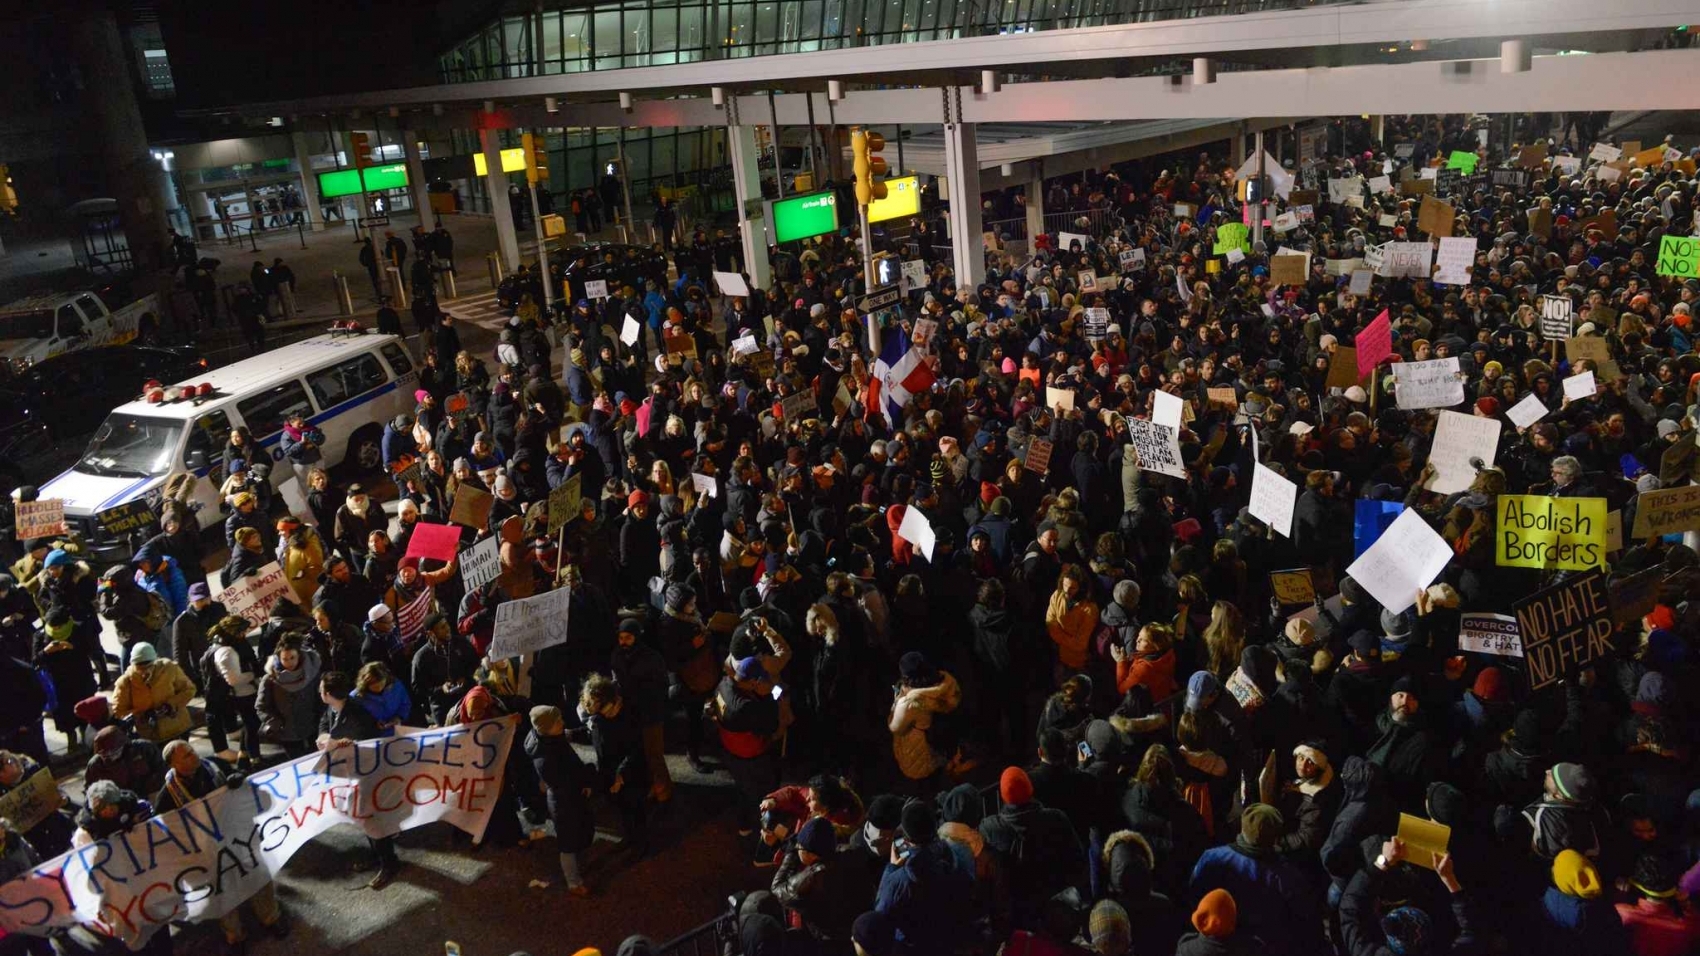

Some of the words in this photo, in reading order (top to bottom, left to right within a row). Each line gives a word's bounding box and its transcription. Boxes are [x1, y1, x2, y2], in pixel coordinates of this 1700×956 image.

[1663, 240, 1692, 257] NO
[1390, 252, 1422, 268] NEVER
[1661, 258, 1690, 273] NO
[869, 296, 883, 307] ONE
[884, 292, 898, 303] WAY
[1543, 299, 1569, 321] NO!
[1153, 423, 1173, 435] THEY
[1153, 431, 1169, 443] FOR
[1647, 493, 1678, 508] THIS
[106, 515, 139, 535] THEM
[1504, 499, 1592, 536] Abolish
[1504, 530, 1600, 566] Borders
[217, 587, 236, 603] END
[228, 569, 283, 606] DETAINMENT
[239, 585, 290, 617] EPORTATION
[1517, 602, 1550, 649] NO
[1548, 574, 1607, 632] HATE
[1464, 620, 1518, 632] OVERCO
[1466, 631, 1514, 643] BIGOTRY
[1483, 639, 1491, 648] &
[1526, 643, 1558, 690] NO
[1557, 618, 1615, 673] FEAR
[289, 774, 495, 829] WELCOME
[0, 799, 224, 927] SYRIAN
[249, 721, 505, 812] REFUGEES
